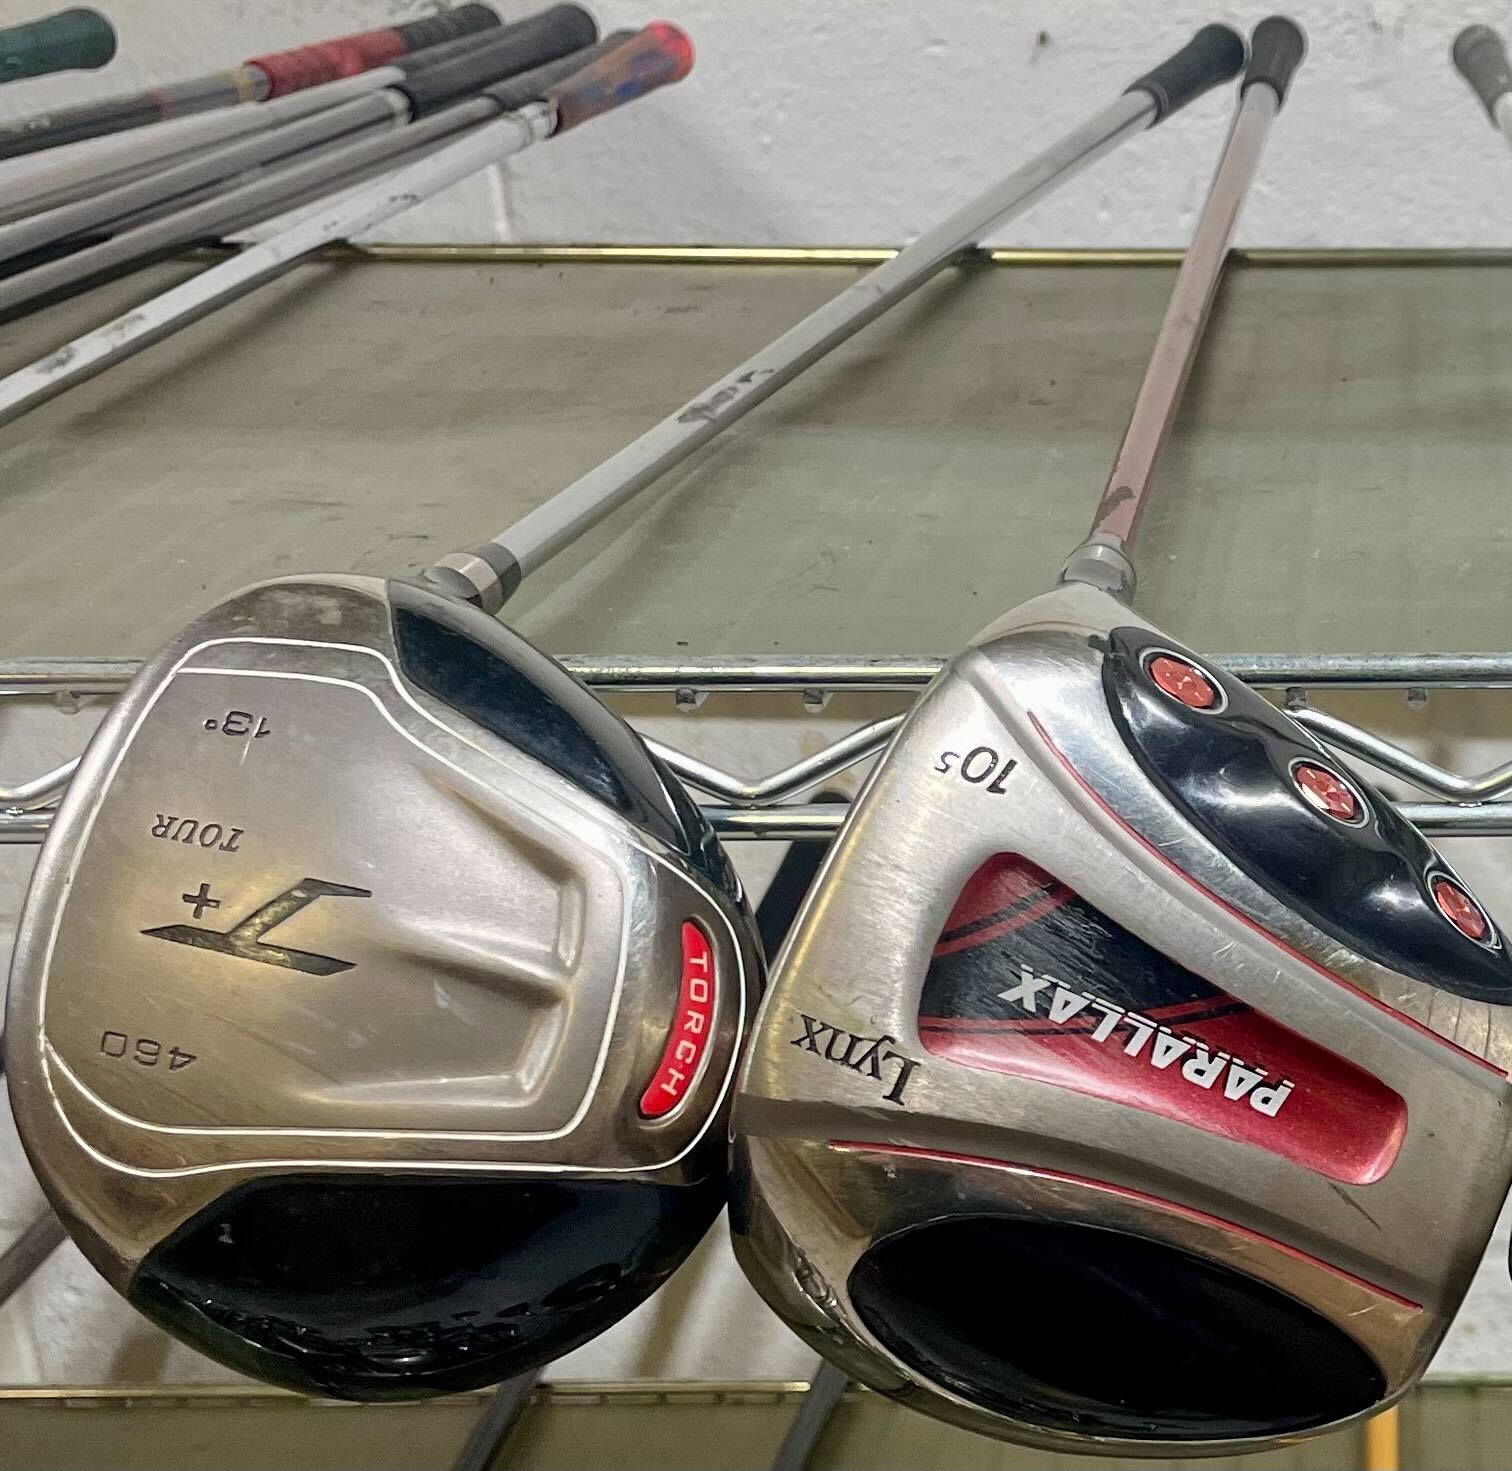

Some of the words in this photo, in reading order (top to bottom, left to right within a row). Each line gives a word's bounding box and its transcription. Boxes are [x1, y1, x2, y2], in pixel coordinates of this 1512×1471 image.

[151, 813, 245, 852] TOUR
[101, 1030, 197, 1071] 460
[661, 951, 708, 1096] TORCH
[790, 1014, 921, 1106] Lynx
[997, 963, 1295, 1118] PARALLAX
